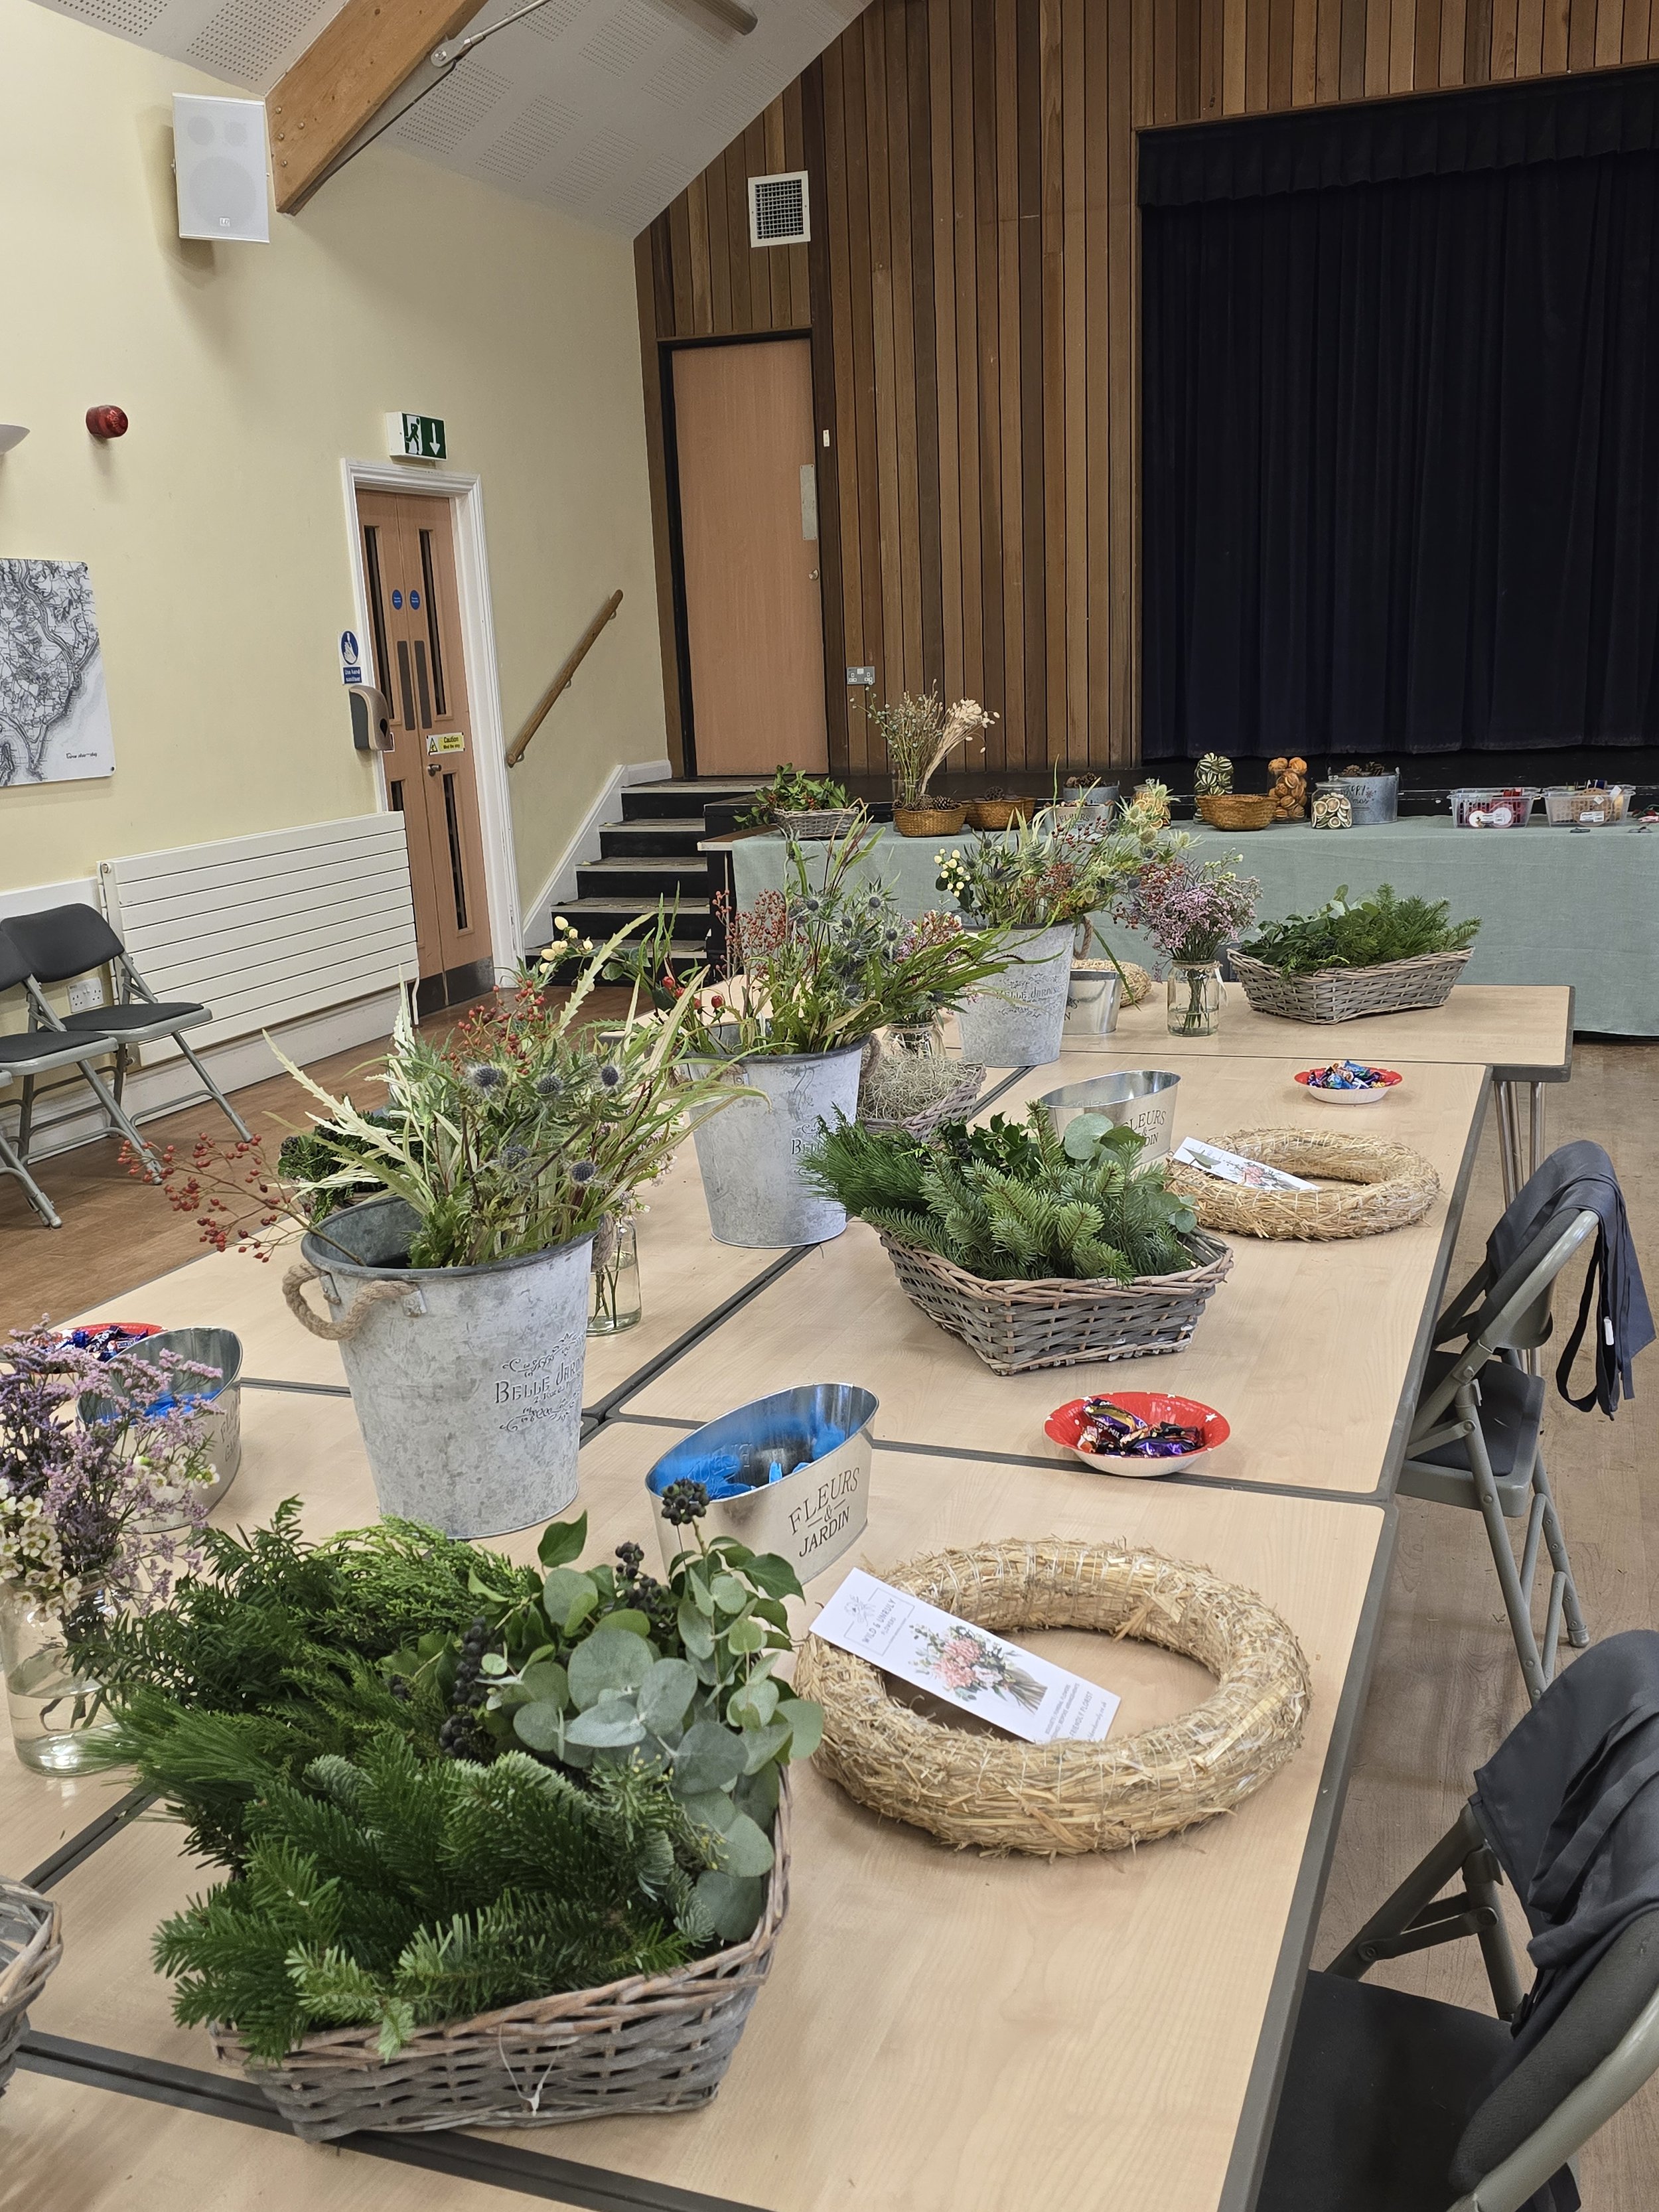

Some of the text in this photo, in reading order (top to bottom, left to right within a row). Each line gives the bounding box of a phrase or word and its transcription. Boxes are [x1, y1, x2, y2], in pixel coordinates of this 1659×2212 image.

[495, 1376, 550, 1404] BELLE
[788, 1467, 860, 1536] FLEURS
[824, 1505, 833, 1522] &
[799, 1506, 850, 1557] JARDIN
[862, 1627, 877, 1643] WILD
[876, 1598, 897, 1623] UNRULY
[1080, 1691, 1093, 1712] FLORIST
